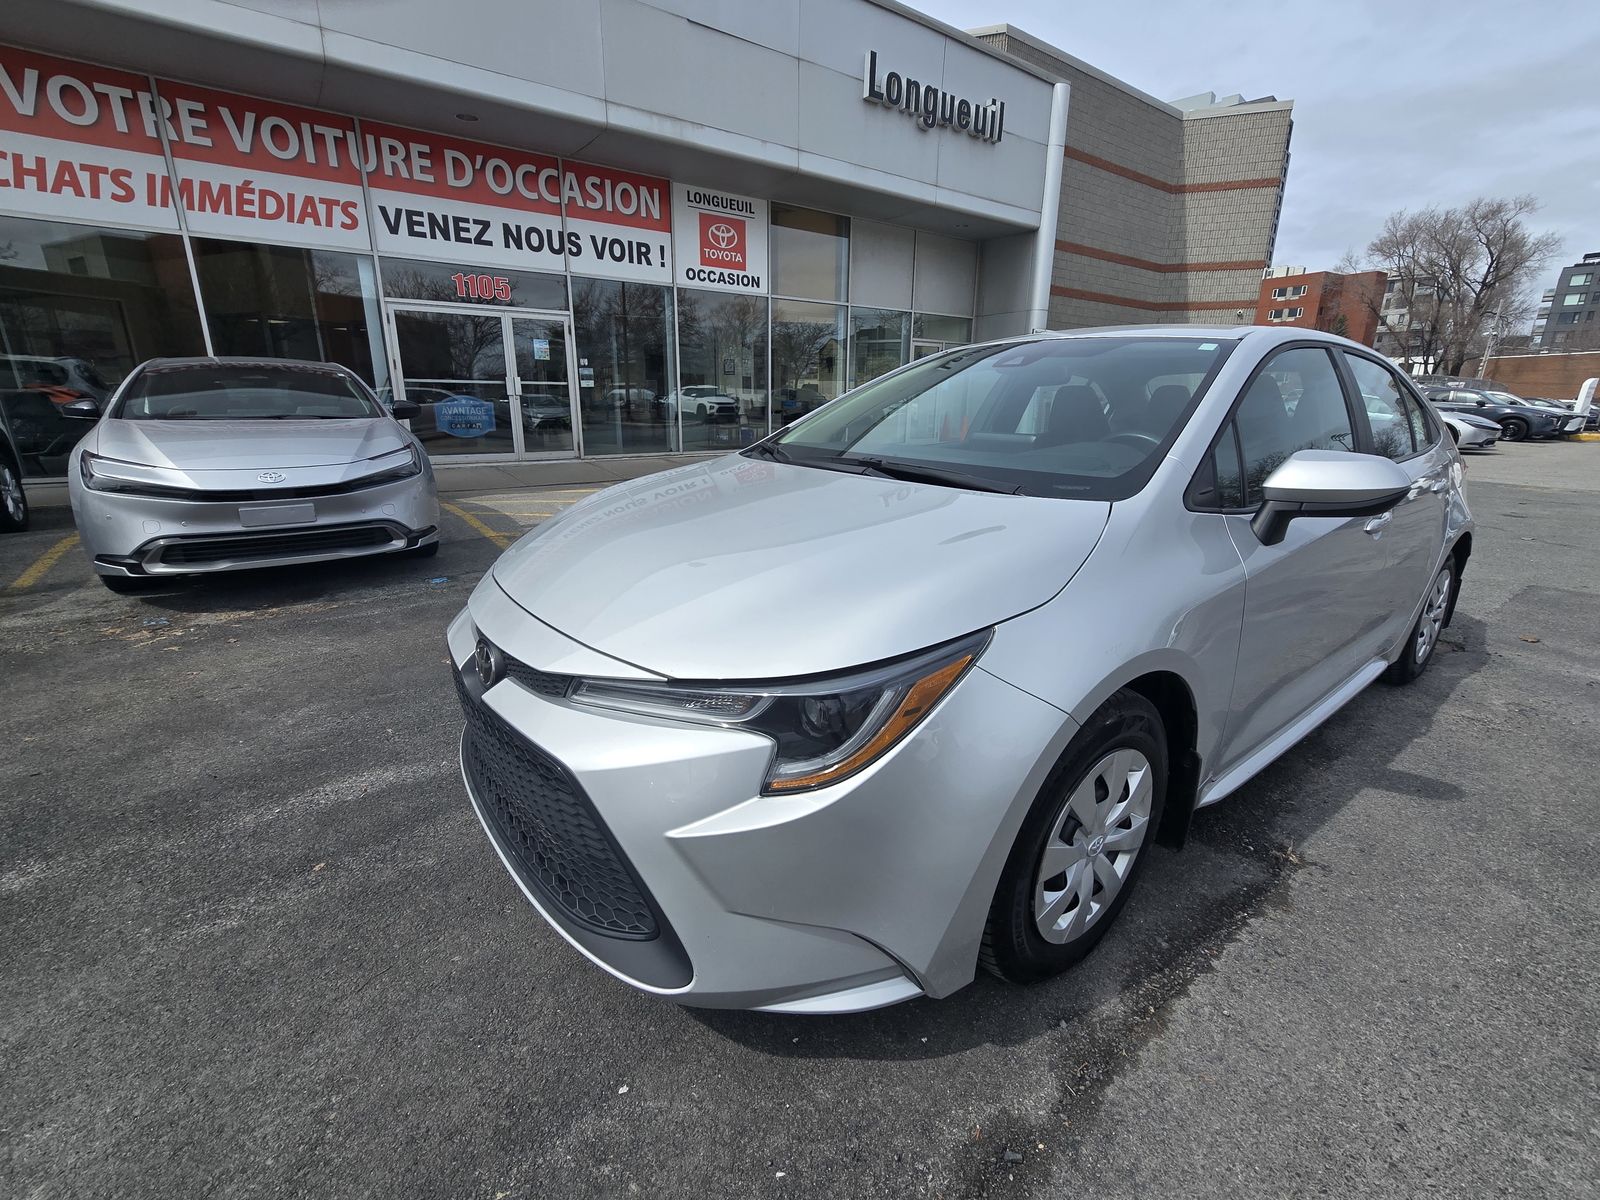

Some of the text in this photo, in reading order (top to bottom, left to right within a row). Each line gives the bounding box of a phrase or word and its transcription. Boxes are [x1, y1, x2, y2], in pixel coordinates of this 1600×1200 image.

[864, 50, 1005, 143] Longueuil
[0, 63, 661, 220] VOTRE VOITURE D'OCCASION
[146, 173, 359, 231] IMMÉDIATS
[687, 190, 755, 214] LONGUEUIL
[378, 205, 493, 247] VENEZ
[503, 223, 583, 257] NOUS
[590, 235, 653, 266] VOIR
[703, 248, 743, 263] TOYOTA
[452, 273, 511, 301] 1105
[686, 267, 761, 288] OCCASION
[442, 406, 487, 415] AVANTAGE
